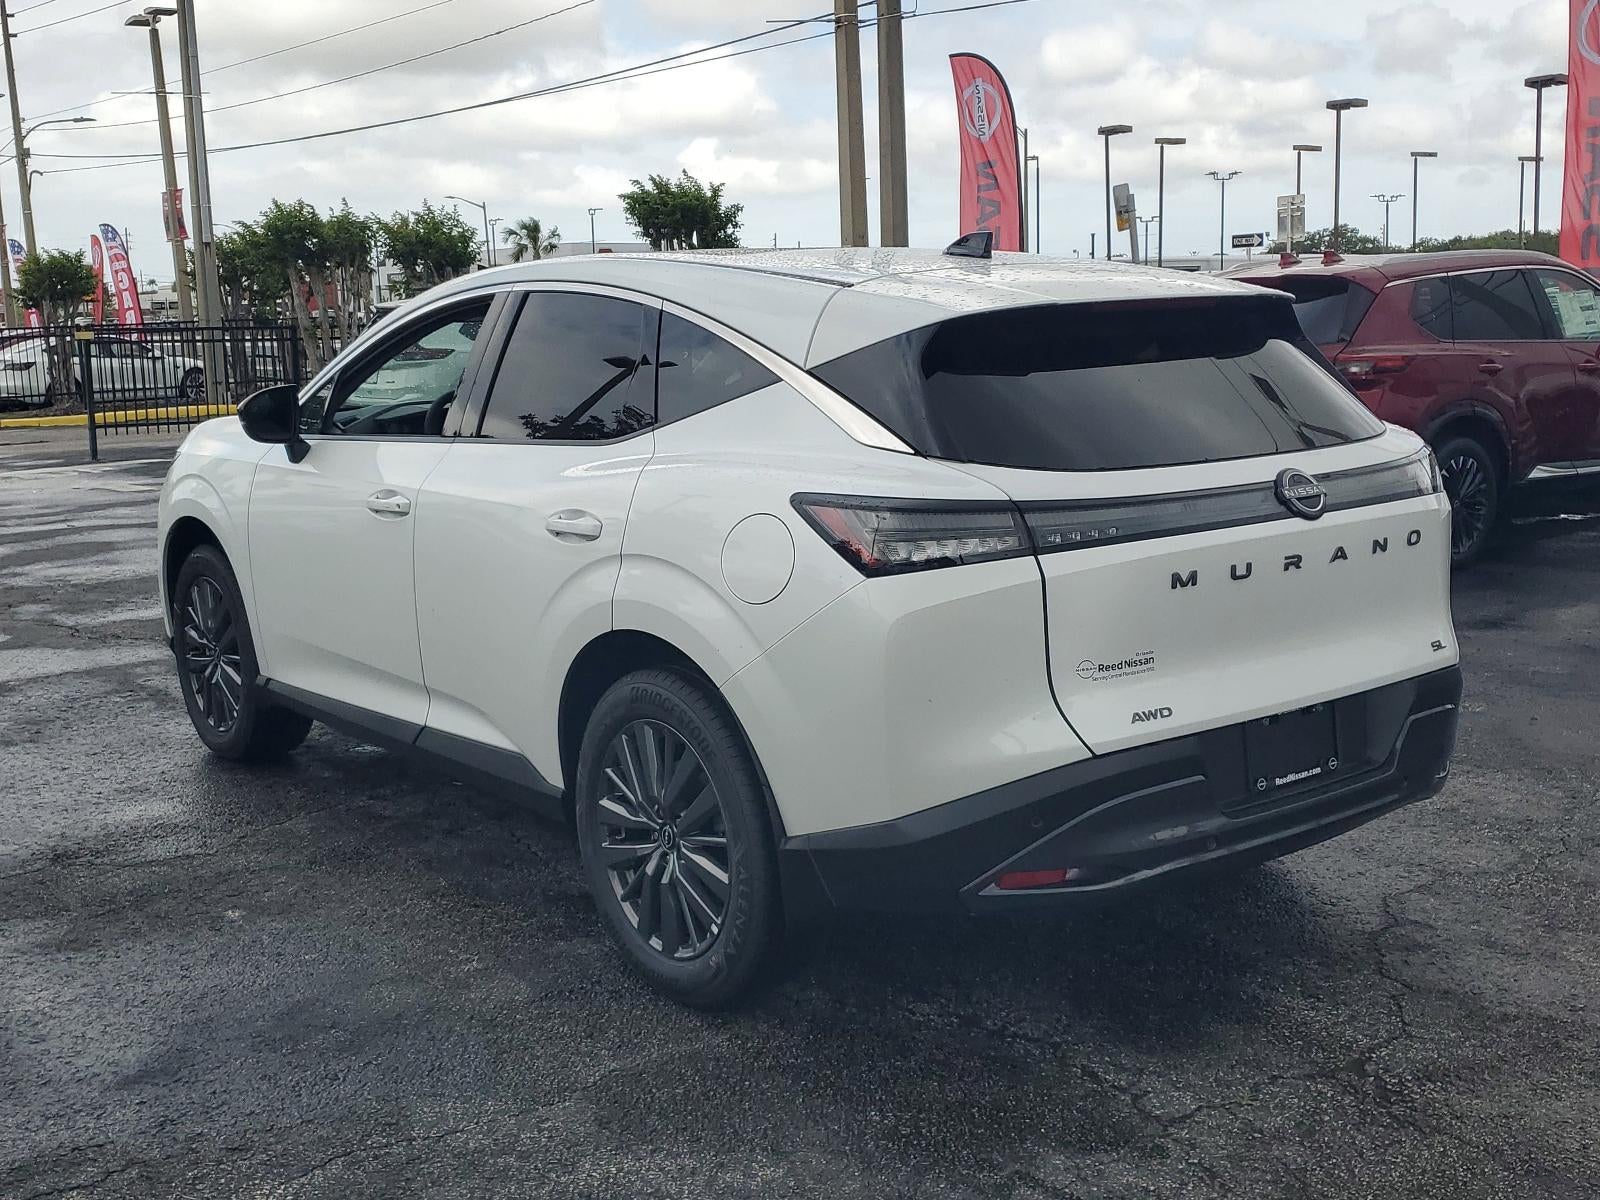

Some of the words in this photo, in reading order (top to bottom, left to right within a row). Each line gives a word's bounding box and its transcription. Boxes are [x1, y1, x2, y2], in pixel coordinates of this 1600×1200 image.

[1285, 484, 1325, 497] NISSAN
[1171, 529, 1422, 589] MURANO
[1431, 640, 1447, 652] SL
[1098, 660, 1123, 673] Reed
[1124, 656, 1155, 669] Nissan
[1130, 706, 1173, 724] AWD
[1275, 767, 1322, 786] ReedNissan.com
